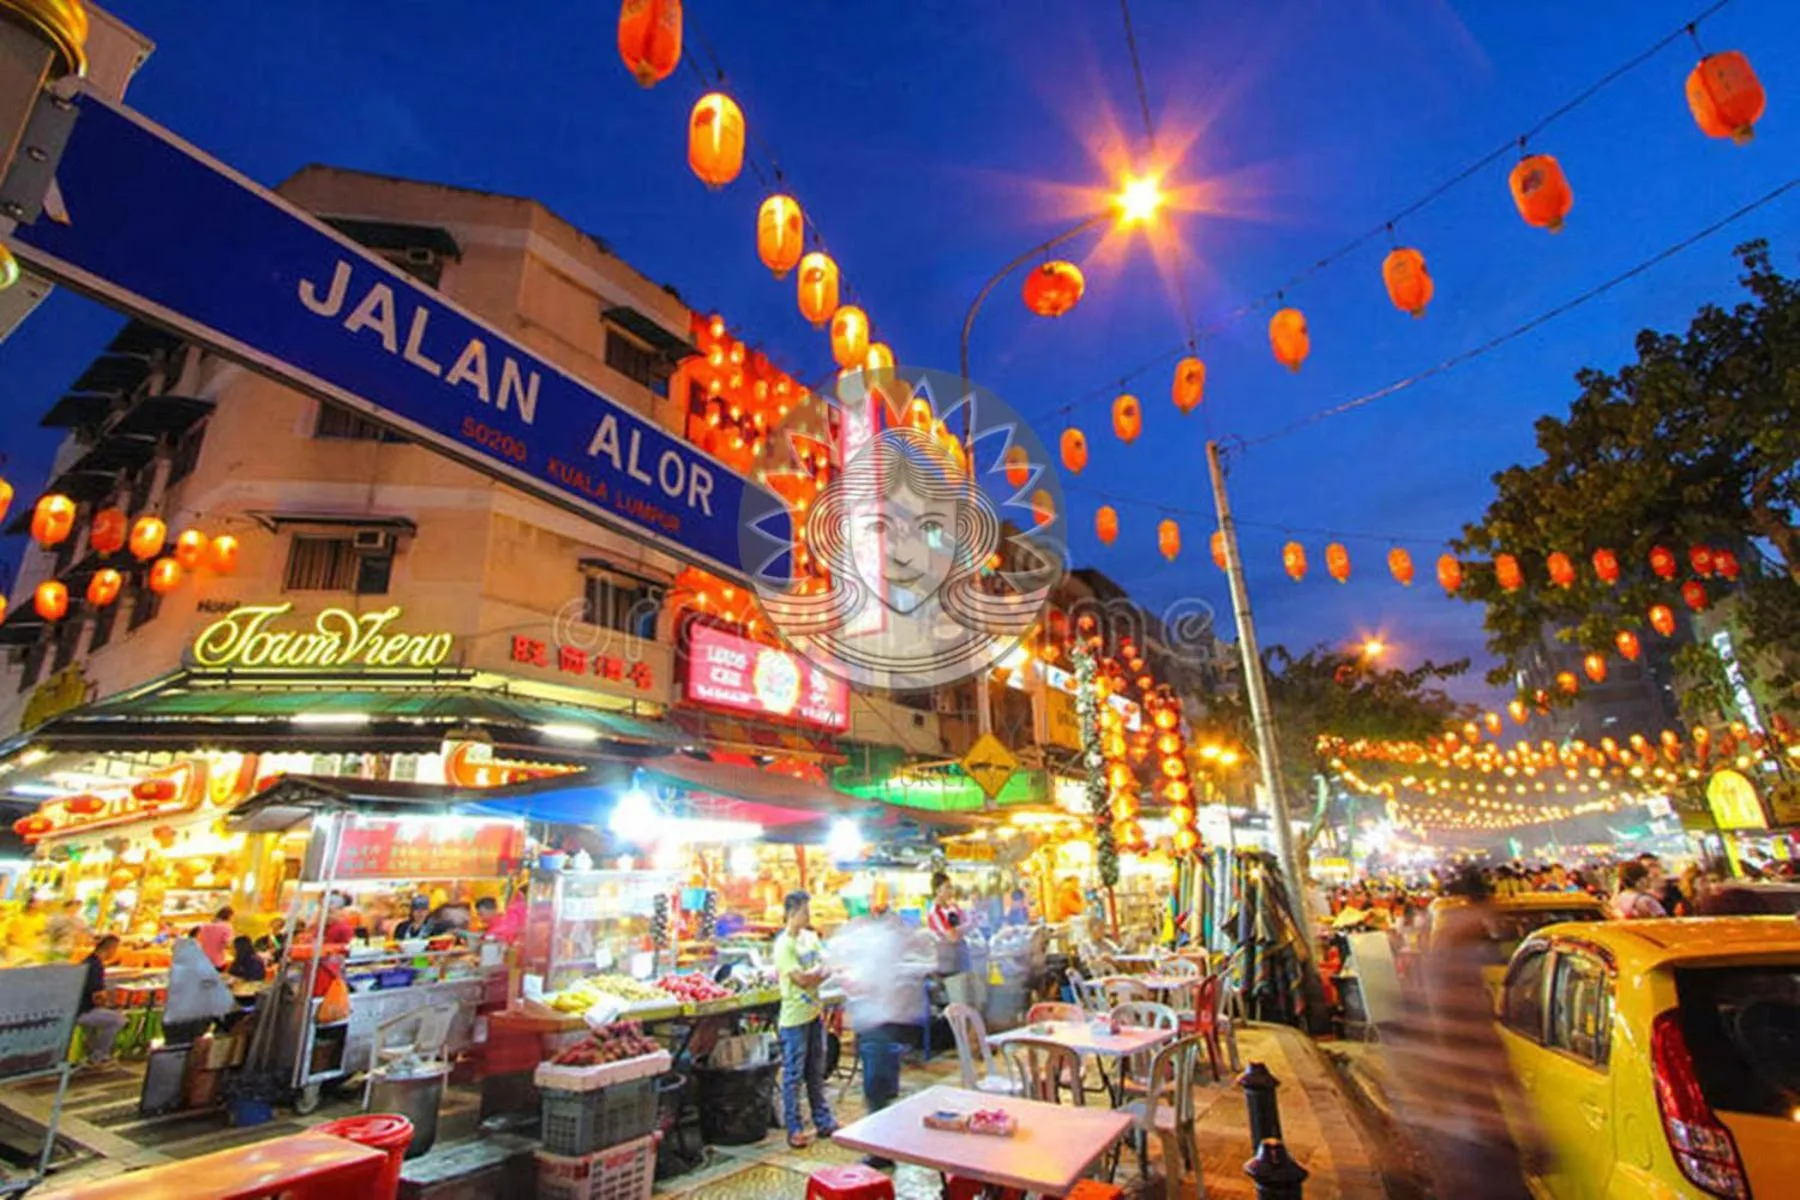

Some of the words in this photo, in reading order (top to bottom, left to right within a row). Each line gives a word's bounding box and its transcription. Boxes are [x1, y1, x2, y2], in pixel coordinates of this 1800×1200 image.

[298, 260, 541, 425] JALAN
[588, 413, 714, 517] ALOR
[462, 416, 527, 462] 50200
[547, 457, 609, 501] KUALA
[615, 491, 681, 533] LUMPUR
